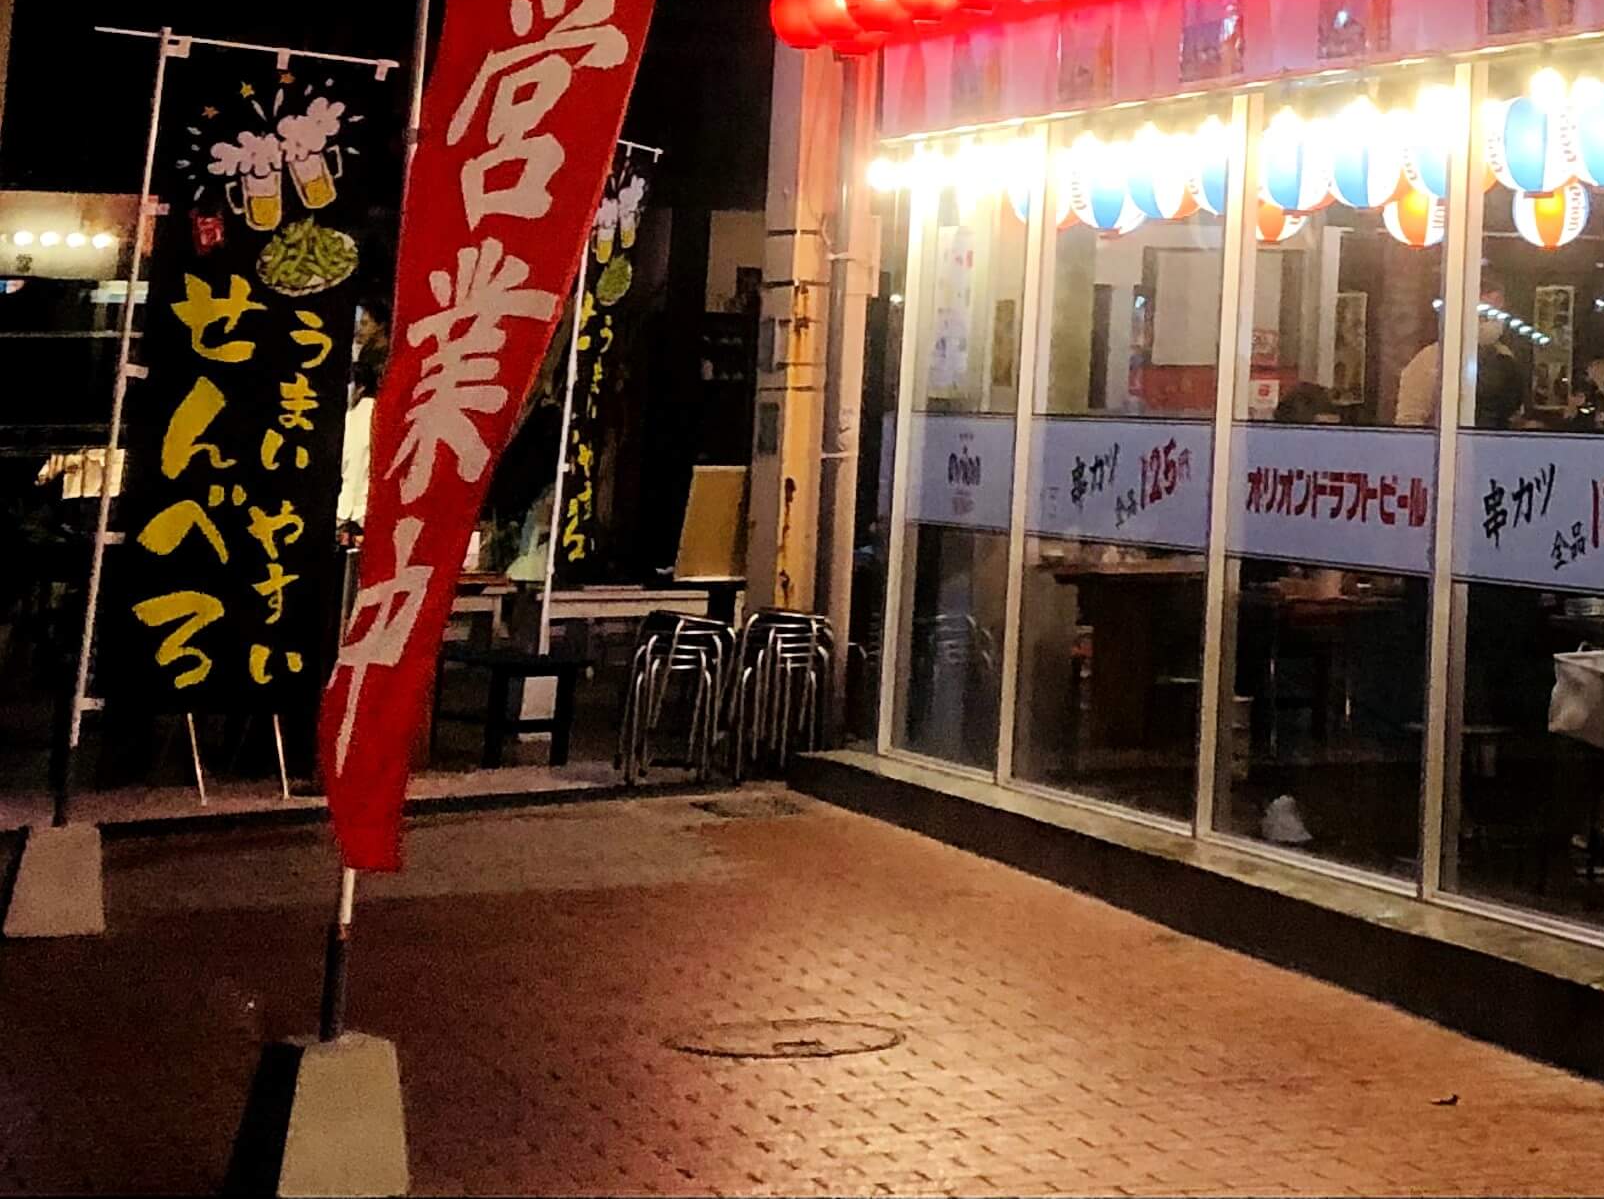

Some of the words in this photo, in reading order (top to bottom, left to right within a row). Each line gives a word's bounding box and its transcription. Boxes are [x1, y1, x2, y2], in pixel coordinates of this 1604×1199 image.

[132, 274, 267, 689] せんべろ
[1246, 467, 1429, 529] オリオンドラフトビール
[1483, 463, 1556, 549] 串カツ
